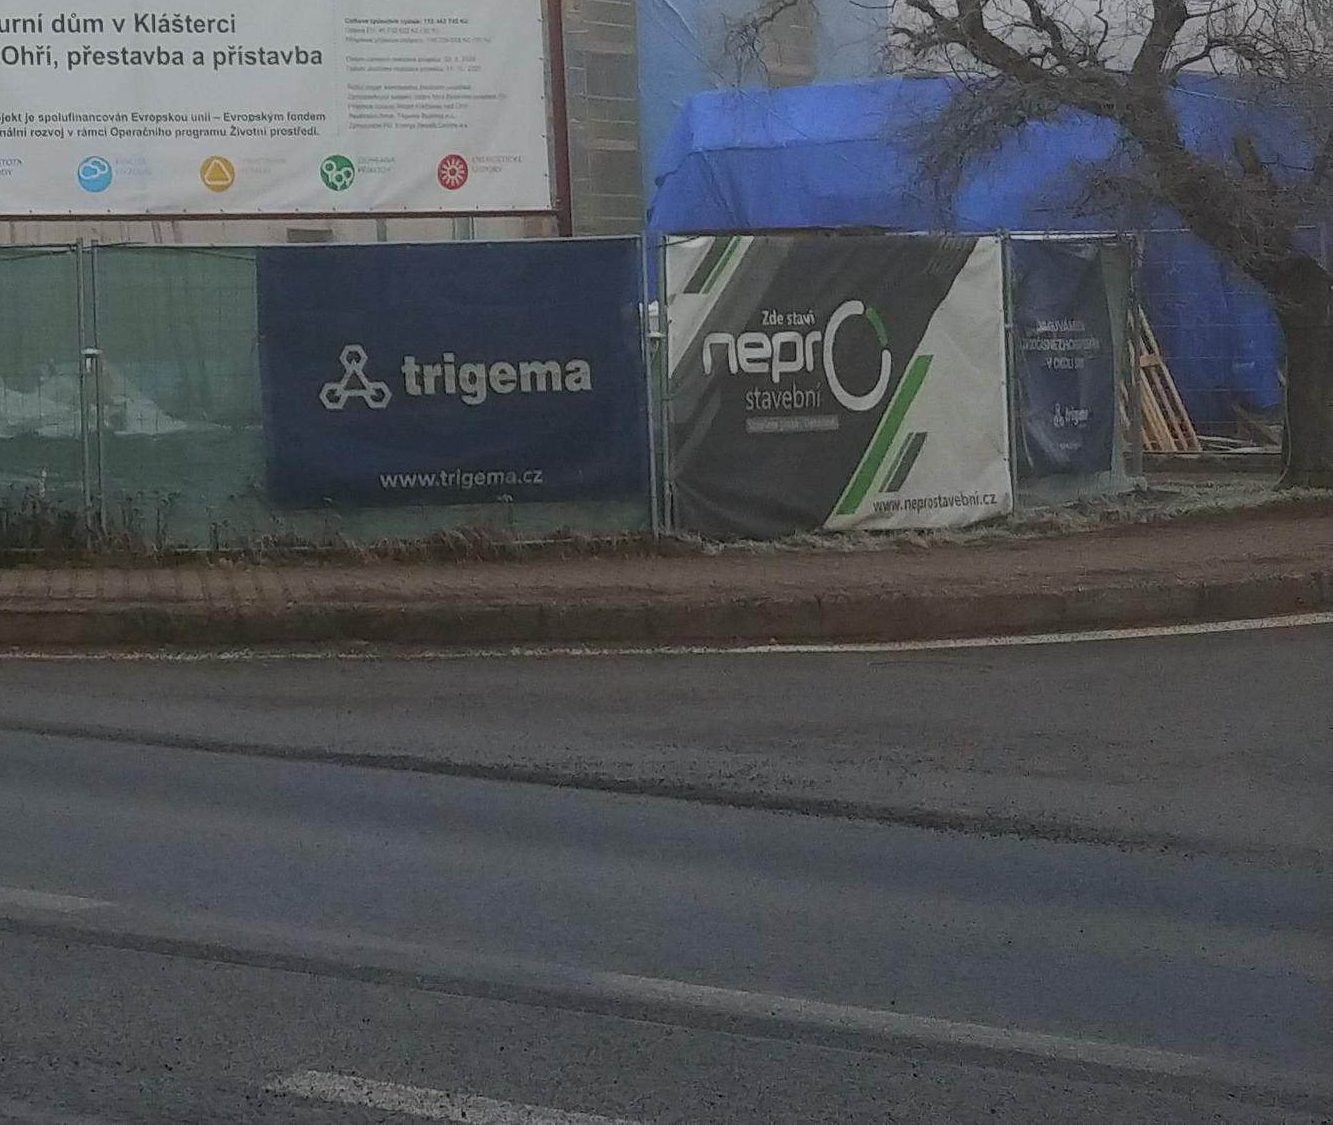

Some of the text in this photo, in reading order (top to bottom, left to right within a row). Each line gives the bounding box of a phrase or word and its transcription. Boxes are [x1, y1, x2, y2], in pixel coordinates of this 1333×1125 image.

[51, 13, 104, 33] dům
[112, 18, 125, 33] v
[133, 13, 236, 33] Klášterci
[1, 45, 59, 69] Ohří,
[67, 45, 184, 71] přestavba
[192, 50, 205, 66] a
[212, 45, 323, 71] přístavba
[25, 112, 34, 125] je
[38, 112, 129, 125] spolufinancován
[131, 111, 187, 124] Evropskou
[287, 111, 326, 122] fondem
[30, 127, 64, 139] rozvoj
[67, 129, 74, 137] v
[175, 128, 227, 139] programu
[762, 310, 783, 325] Zde
[402, 352, 592, 406] trigema
[745, 382, 821, 411] stavební
[379, 468, 544, 489] www.trigema.cz
